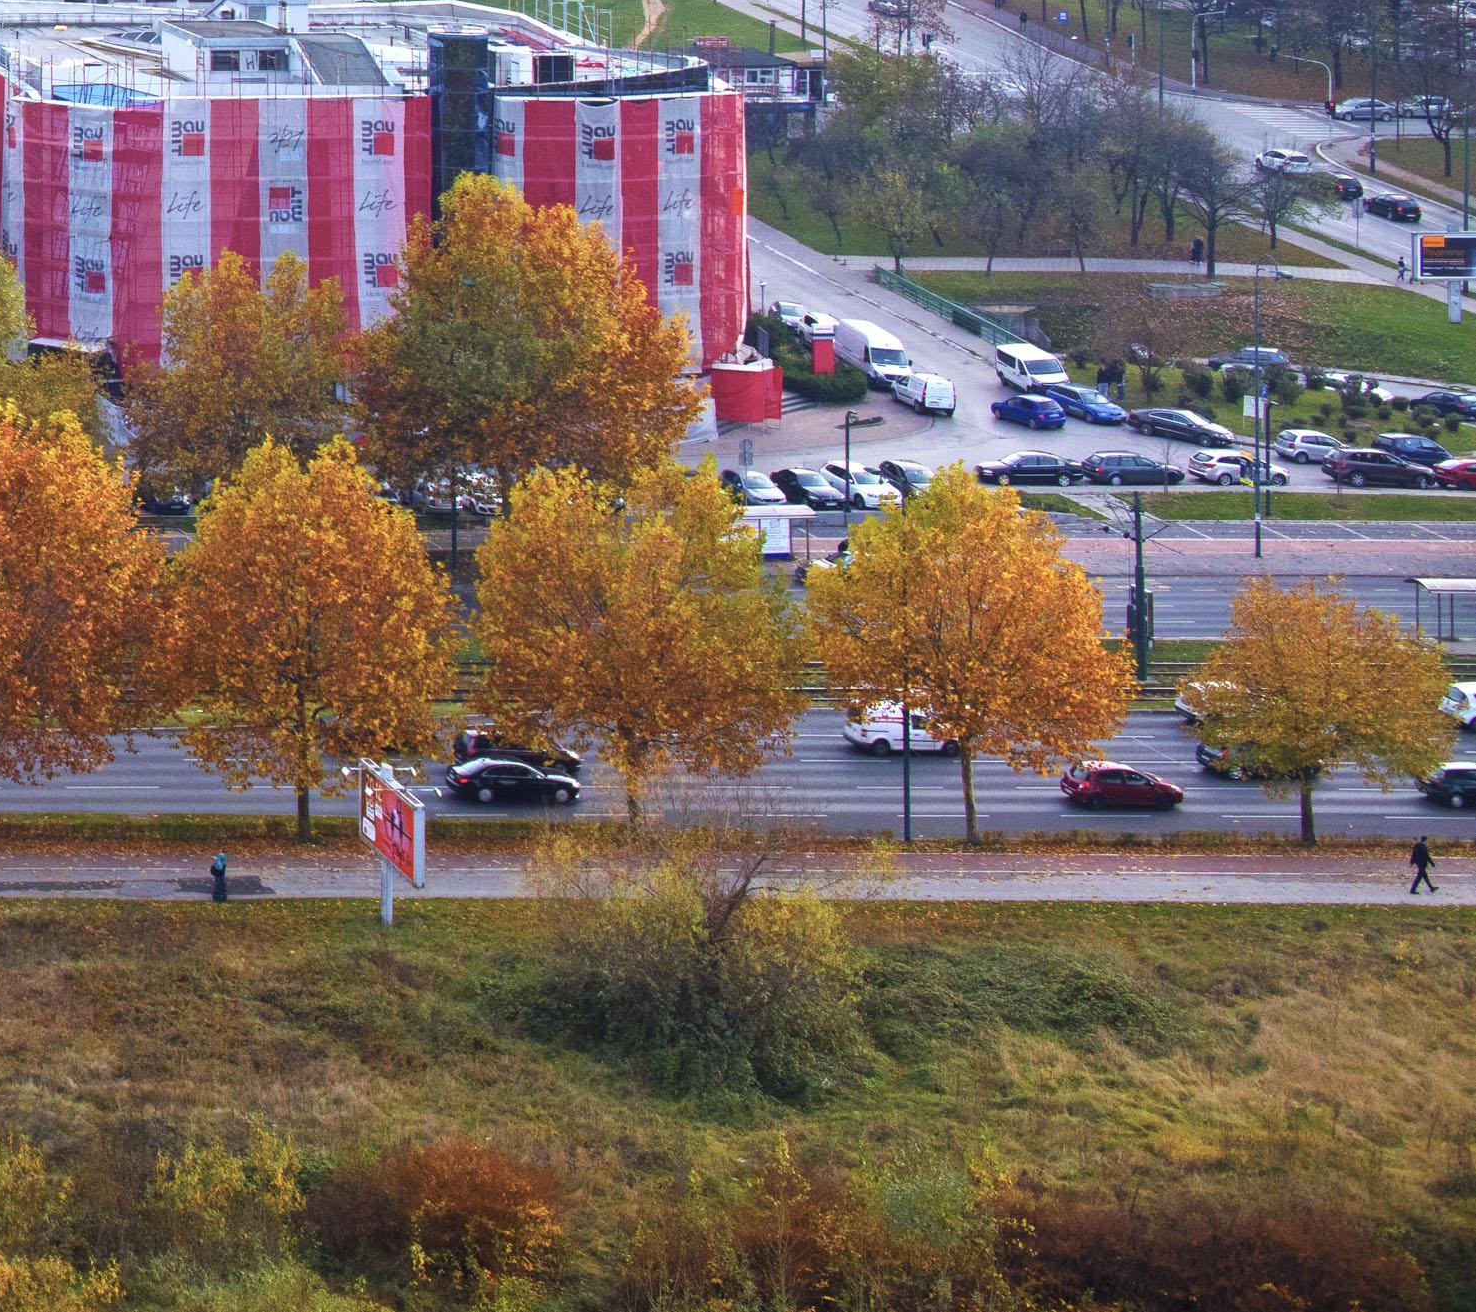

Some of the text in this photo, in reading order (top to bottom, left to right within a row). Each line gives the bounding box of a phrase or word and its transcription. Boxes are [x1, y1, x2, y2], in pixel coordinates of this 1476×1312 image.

[167, 191, 203, 220] Life
[359, 190, 397, 218] Life
[579, 195, 614, 219] Life
[663, 188, 695, 216] Life
